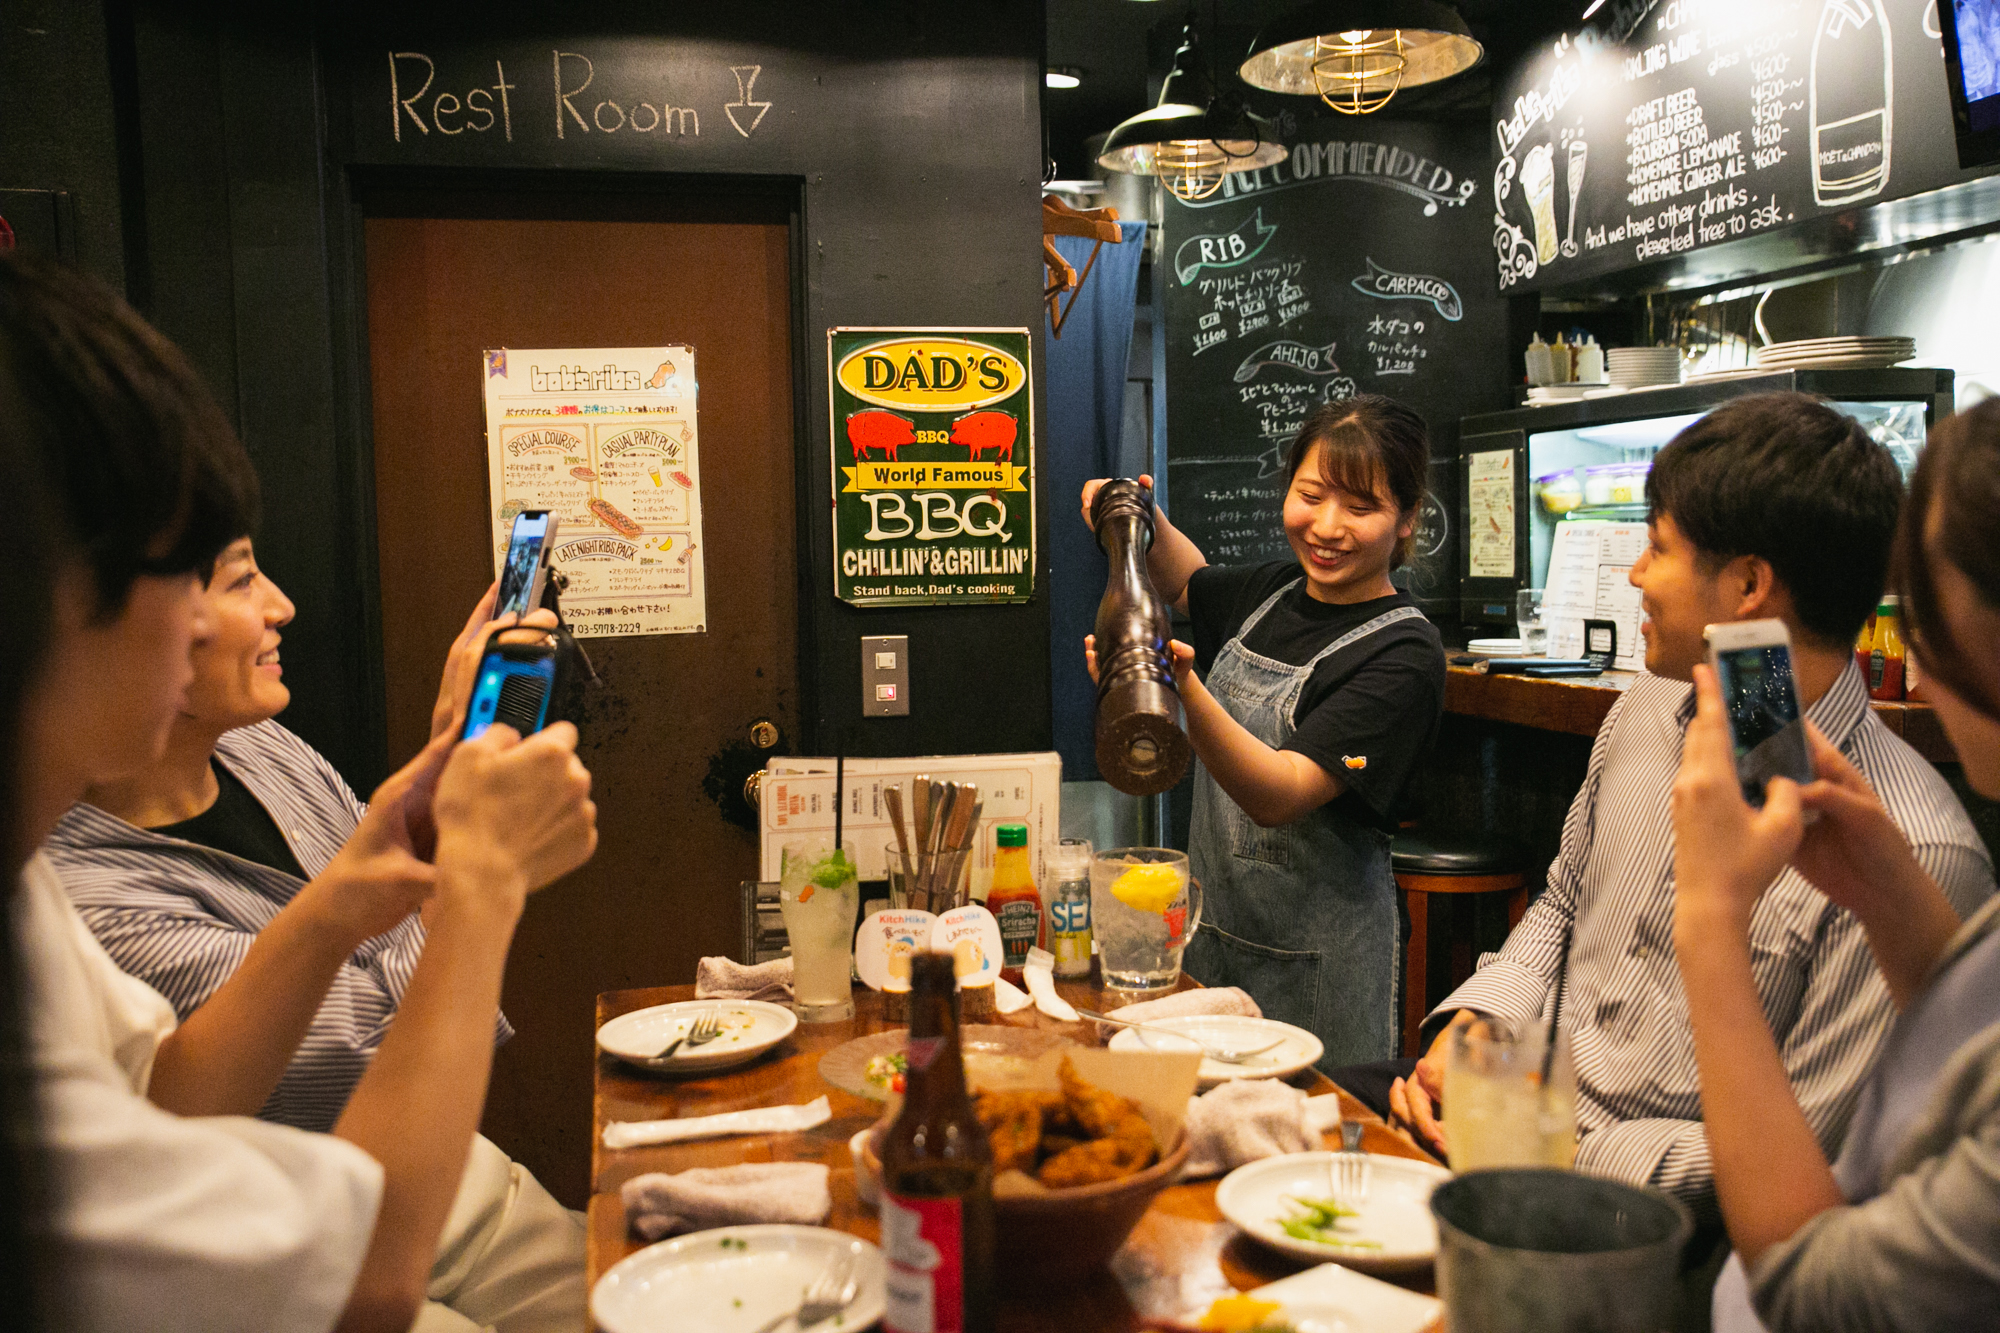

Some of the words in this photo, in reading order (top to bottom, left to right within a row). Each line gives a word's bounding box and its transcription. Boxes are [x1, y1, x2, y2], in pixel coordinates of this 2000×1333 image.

[1669, 29, 1701, 65] WINE
[388, 50, 516, 142] Rest
[552, 49, 700, 140] Room
[1632, 97, 1665, 126] DRAFT
[1666, 87, 1697, 117] BEER
[1632, 116, 1674, 148] BOTTLED
[1673, 106, 1703, 134] BEER
[1632, 134, 1680, 168] BOURBON
[1680, 124, 1708, 151] SODA
[1632, 154, 1682, 185] HOMEMADE
[1683, 131, 1742, 170] LEMONADE
[1633, 173, 1683, 207] HOMEMADE
[1683, 162, 1724, 192] GINGER
[1724, 154, 1747, 180] ALE
[1584, 224, 1607, 250] And
[1608, 228, 1626, 245] we
[1626, 214, 1655, 239] have
[1658, 203, 1697, 230] other
[1698, 214, 1727, 245] free
[1726, 213, 1747, 235] to
[1199, 233, 1247, 264] RIB
[1269, 344, 1319, 370] AHIJO
[863, 356, 1010, 393] DAD'S
[507, 431, 544, 457] SPECIAL
[544, 430, 580, 453] COURSE
[601, 434, 635, 459] CASUAL
[633, 429, 660, 448] PARTY
[658, 435, 682, 459] PLAN
[916, 430, 950, 445] BBQ
[874, 467, 926, 483] World
[932, 467, 1004, 482] Famous
[860, 492, 1013, 544] BBQ
[554, 543, 577, 563] LATE
[575, 539, 598, 556] NIGHT
[597, 539, 616, 555] RIBS
[615, 543, 638, 562] PACK
[853, 584, 890, 597] Stand
[967, 583, 1016, 596] cooking
[577, 622, 641, 635] 03-5778-2229
[879, 914, 928, 924] KitchHike
[945, 912, 982, 926] KitchHike
[1001, 917, 1037, 928] Sriracha
[1006, 904, 1032, 914] HEINZ
